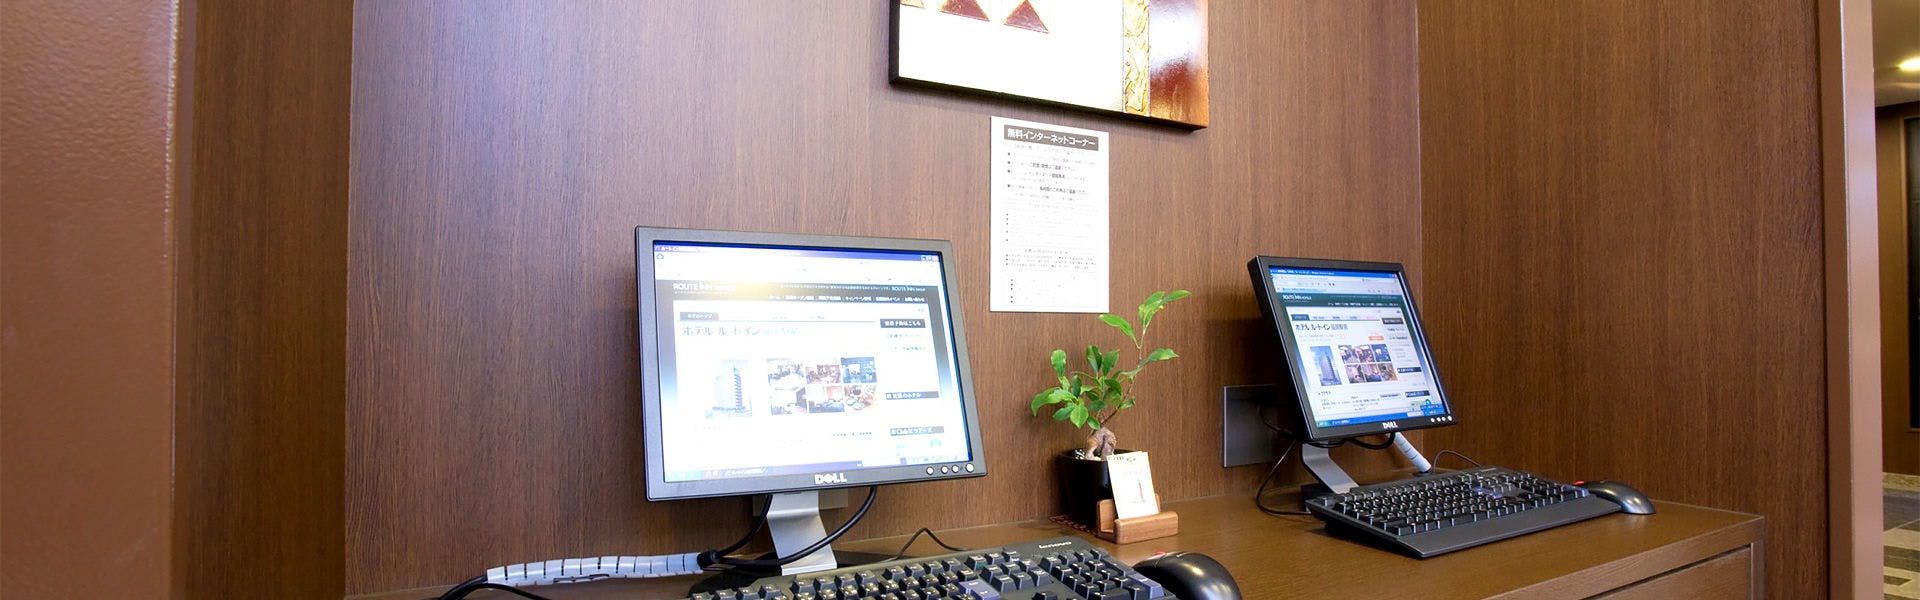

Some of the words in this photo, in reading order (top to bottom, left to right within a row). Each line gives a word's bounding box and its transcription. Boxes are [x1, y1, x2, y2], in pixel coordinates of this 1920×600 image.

[1007, 128, 1096, 147] 無料インターネットコーナー
[1382, 420, 1398, 430] DELL
[815, 472, 847, 485] DELL
